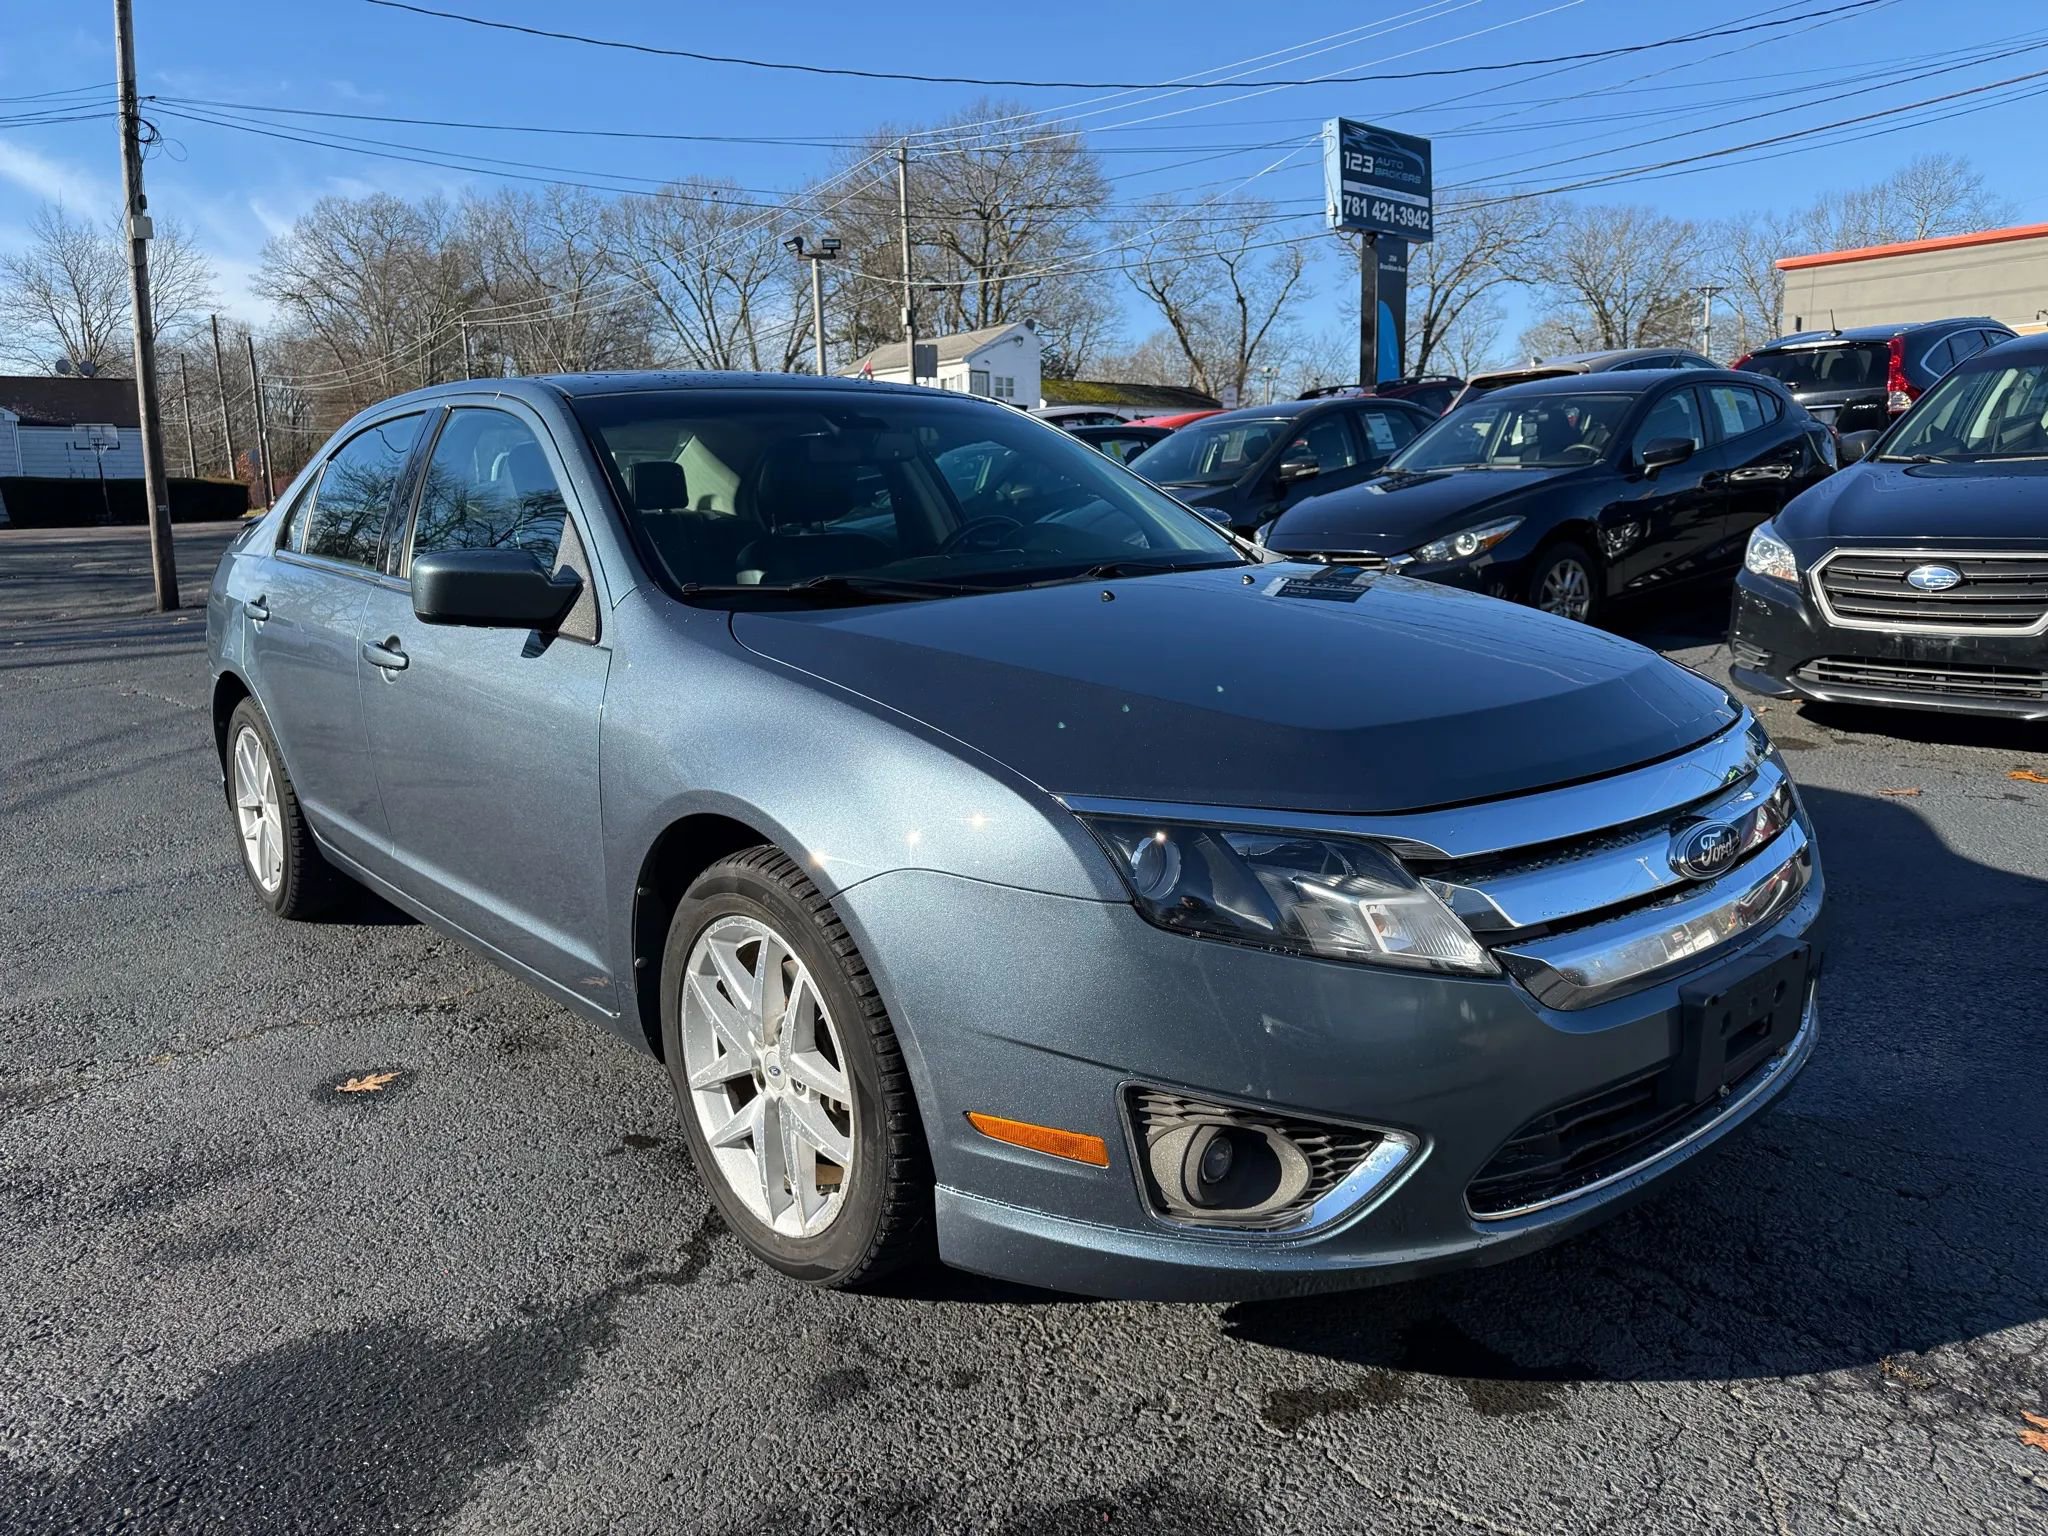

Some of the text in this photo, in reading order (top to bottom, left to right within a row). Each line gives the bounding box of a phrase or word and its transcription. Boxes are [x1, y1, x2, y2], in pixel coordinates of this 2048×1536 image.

[1344, 151, 1374, 174] 123
[1375, 157, 1404, 169] AUTO
[1374, 167, 1421, 184] BROKERS
[1343, 194, 1368, 218] 781
[1372, 201, 1430, 230] 421-3942
[1701, 830, 1735, 867] Ford
